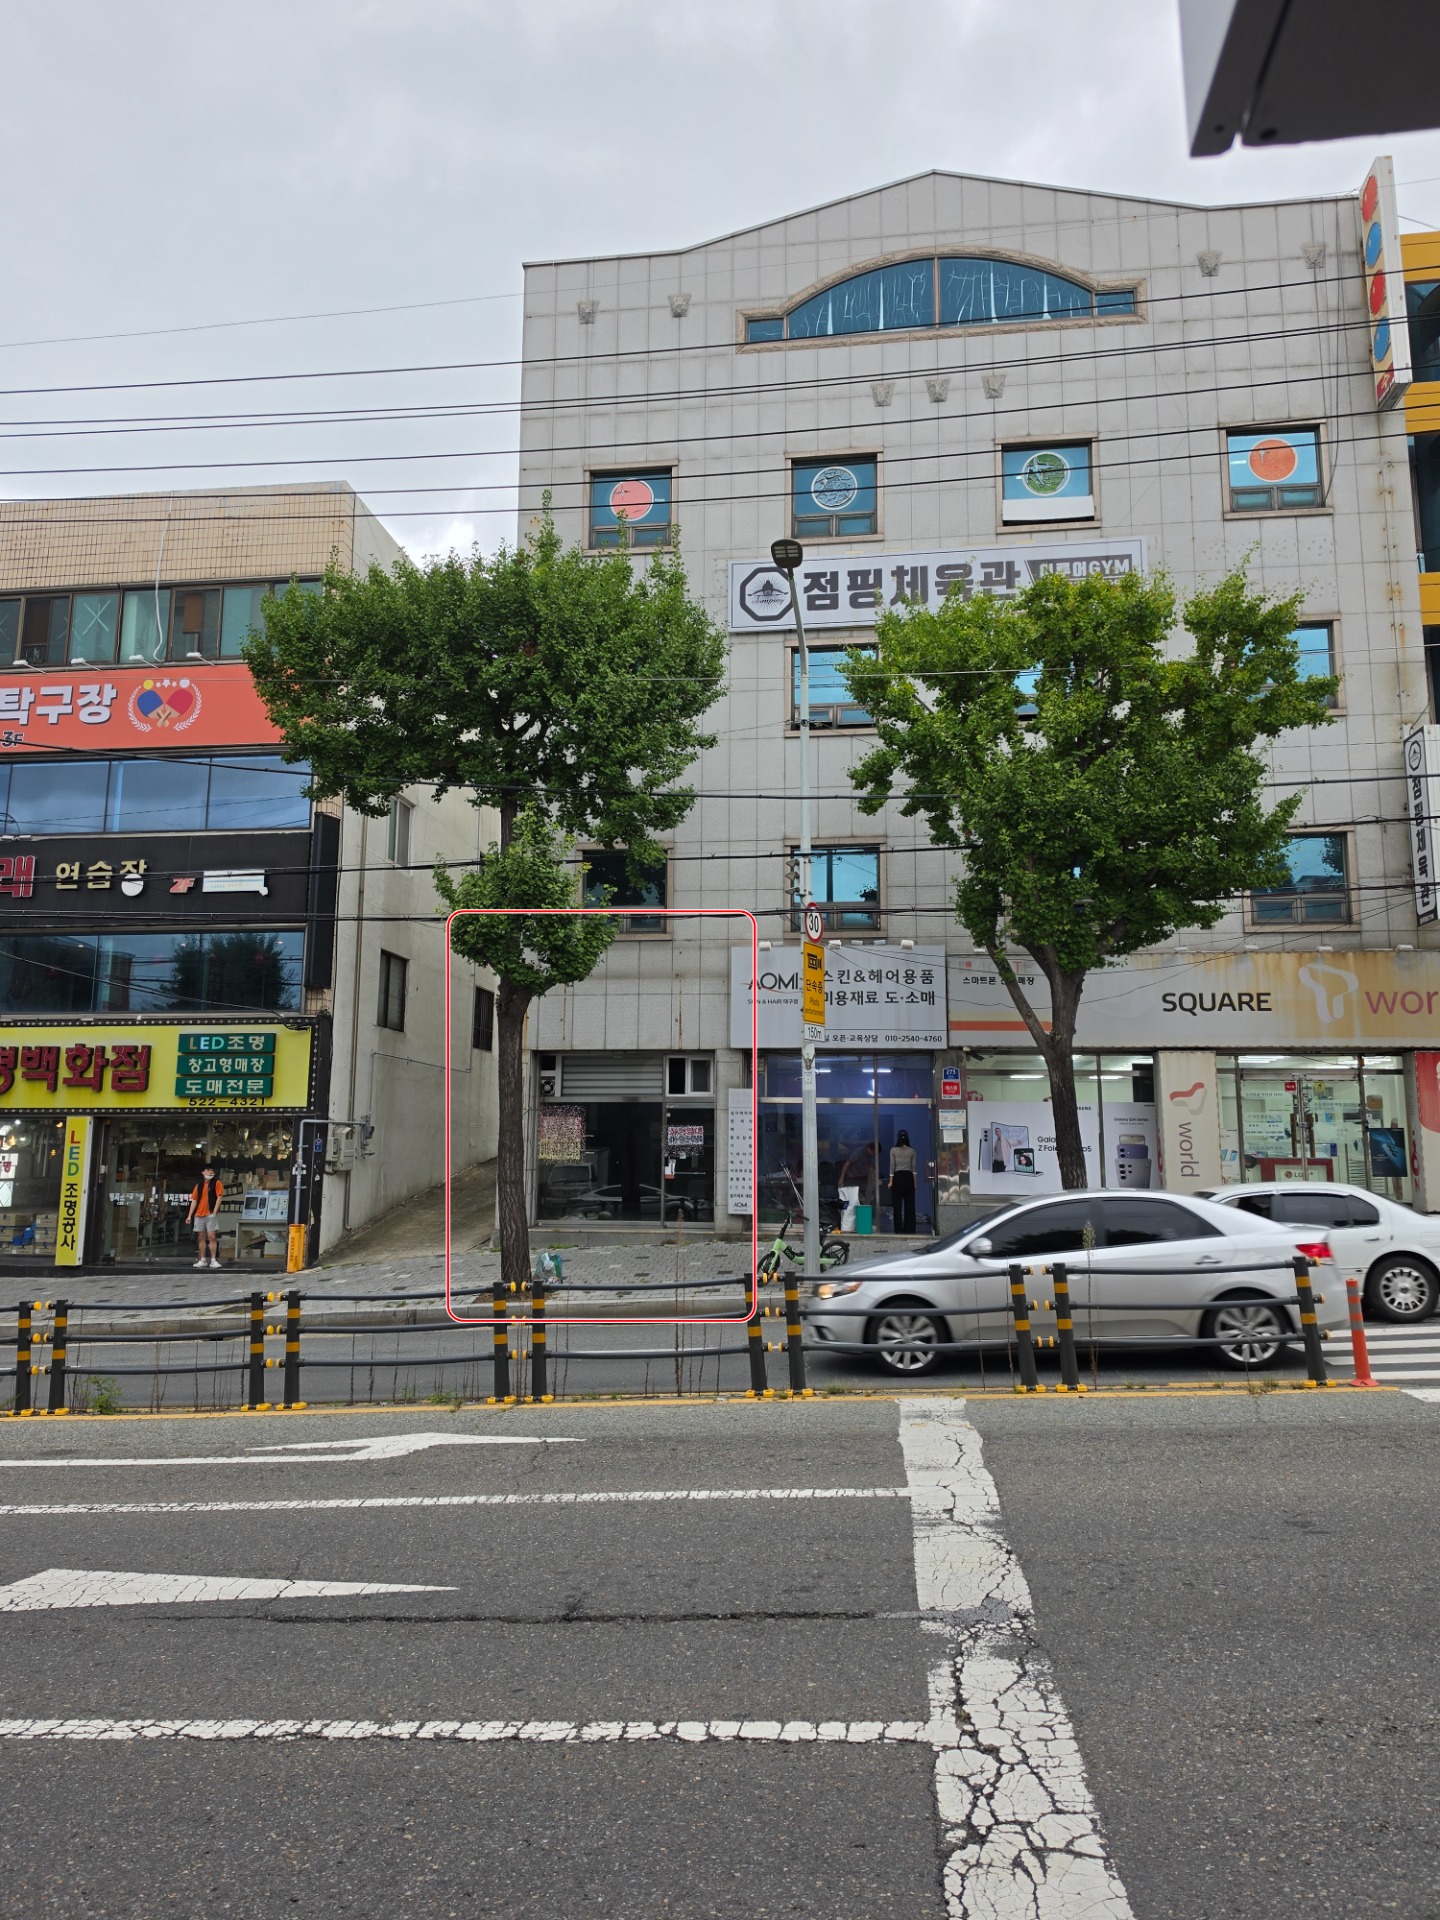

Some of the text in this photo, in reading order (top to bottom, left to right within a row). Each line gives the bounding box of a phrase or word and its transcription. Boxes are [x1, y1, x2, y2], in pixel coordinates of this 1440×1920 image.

[803, 560, 1020, 611] 점핑체육관
[0, 683, 117, 725] 탁구장
[2, 731, 24, 747] 3F
[56, 859, 147, 897] 연습장
[808, 914, 819, 932] 30
[806, 978, 823, 995] 단속중
[963, 976, 996, 985] 스마트폰
[1161, 992, 1272, 1016] SQUARE
[807, 1025, 822, 1039] 150m
[885, 1035, 943, 1043] 010-2540-4760
[188, 1056, 265, 1074] 창고형매장
[185, 1077, 265, 1095] 도매전문
[189, 1097, 266, 1106] 522-4321
[1178, 1121, 1200, 1178] world
[60, 1182, 77, 1251] 조명공사
